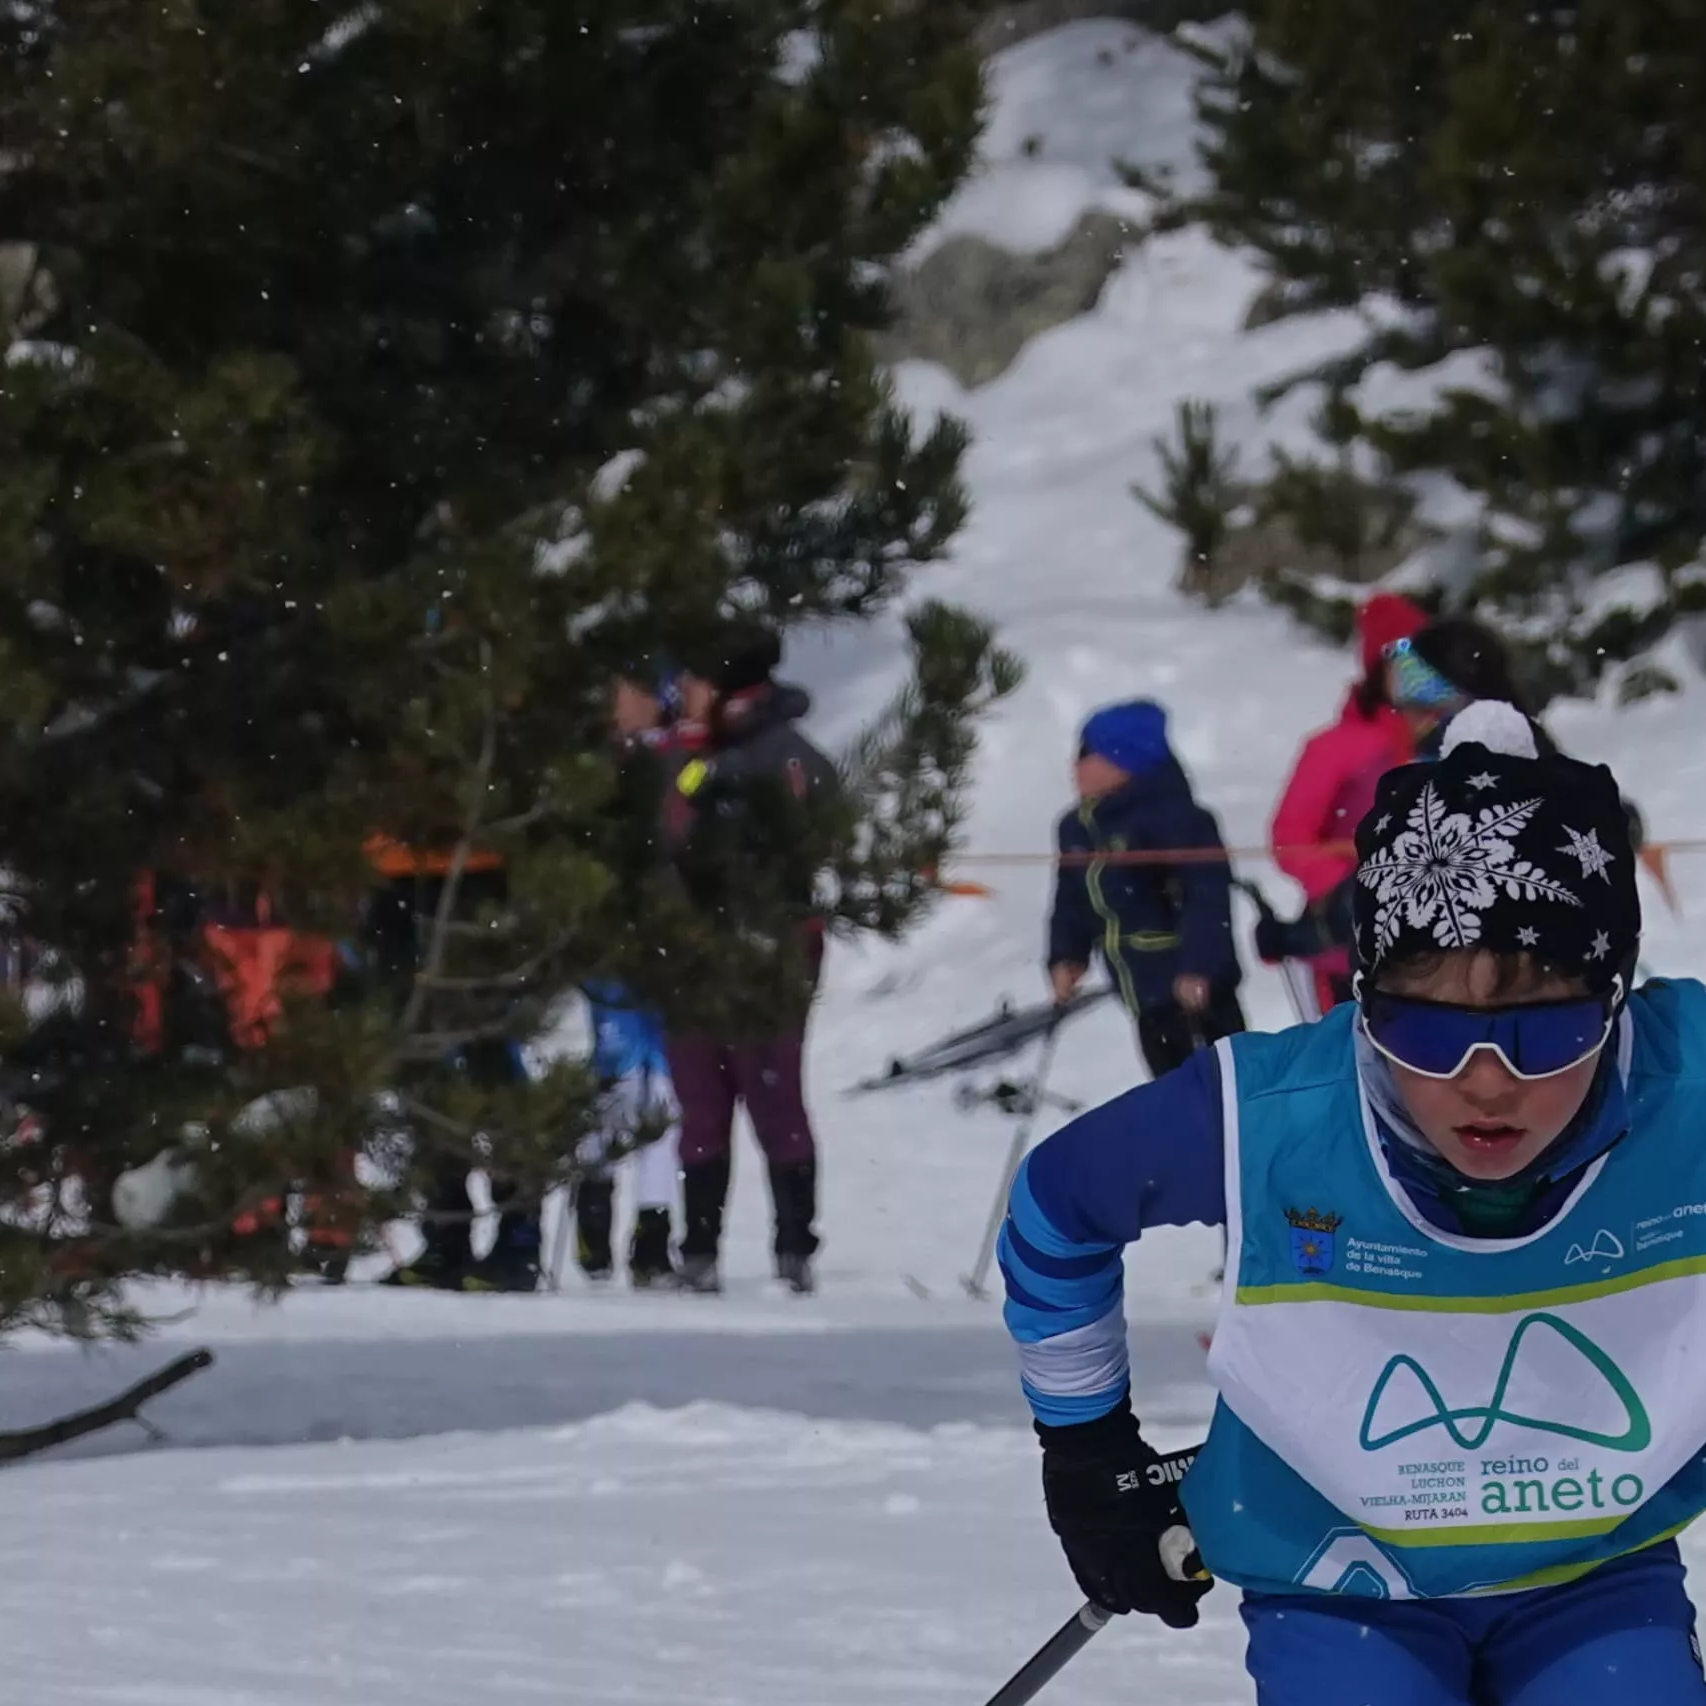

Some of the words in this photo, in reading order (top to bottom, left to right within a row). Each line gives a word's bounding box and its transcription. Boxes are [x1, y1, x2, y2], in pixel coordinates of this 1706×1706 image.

[1346, 1236, 1428, 1258] Ayuntamiento
[1346, 1249, 1361, 1260] de
[1364, 1251, 1376, 1262] la
[1377, 1254, 1401, 1265] villa
[1345, 1262, 1360, 1273] de
[1363, 1262, 1423, 1280] Benasque
[1397, 1461, 1465, 1476] BENASQUE
[1480, 1454, 1549, 1476] reino
[1557, 1457, 1580, 1472] del
[1411, 1476, 1465, 1490] LUCHON
[1480, 1467, 1643, 1515] aneto
[1404, 1507, 1438, 1521] RUTA
[1440, 1507, 1469, 1520] 3404
